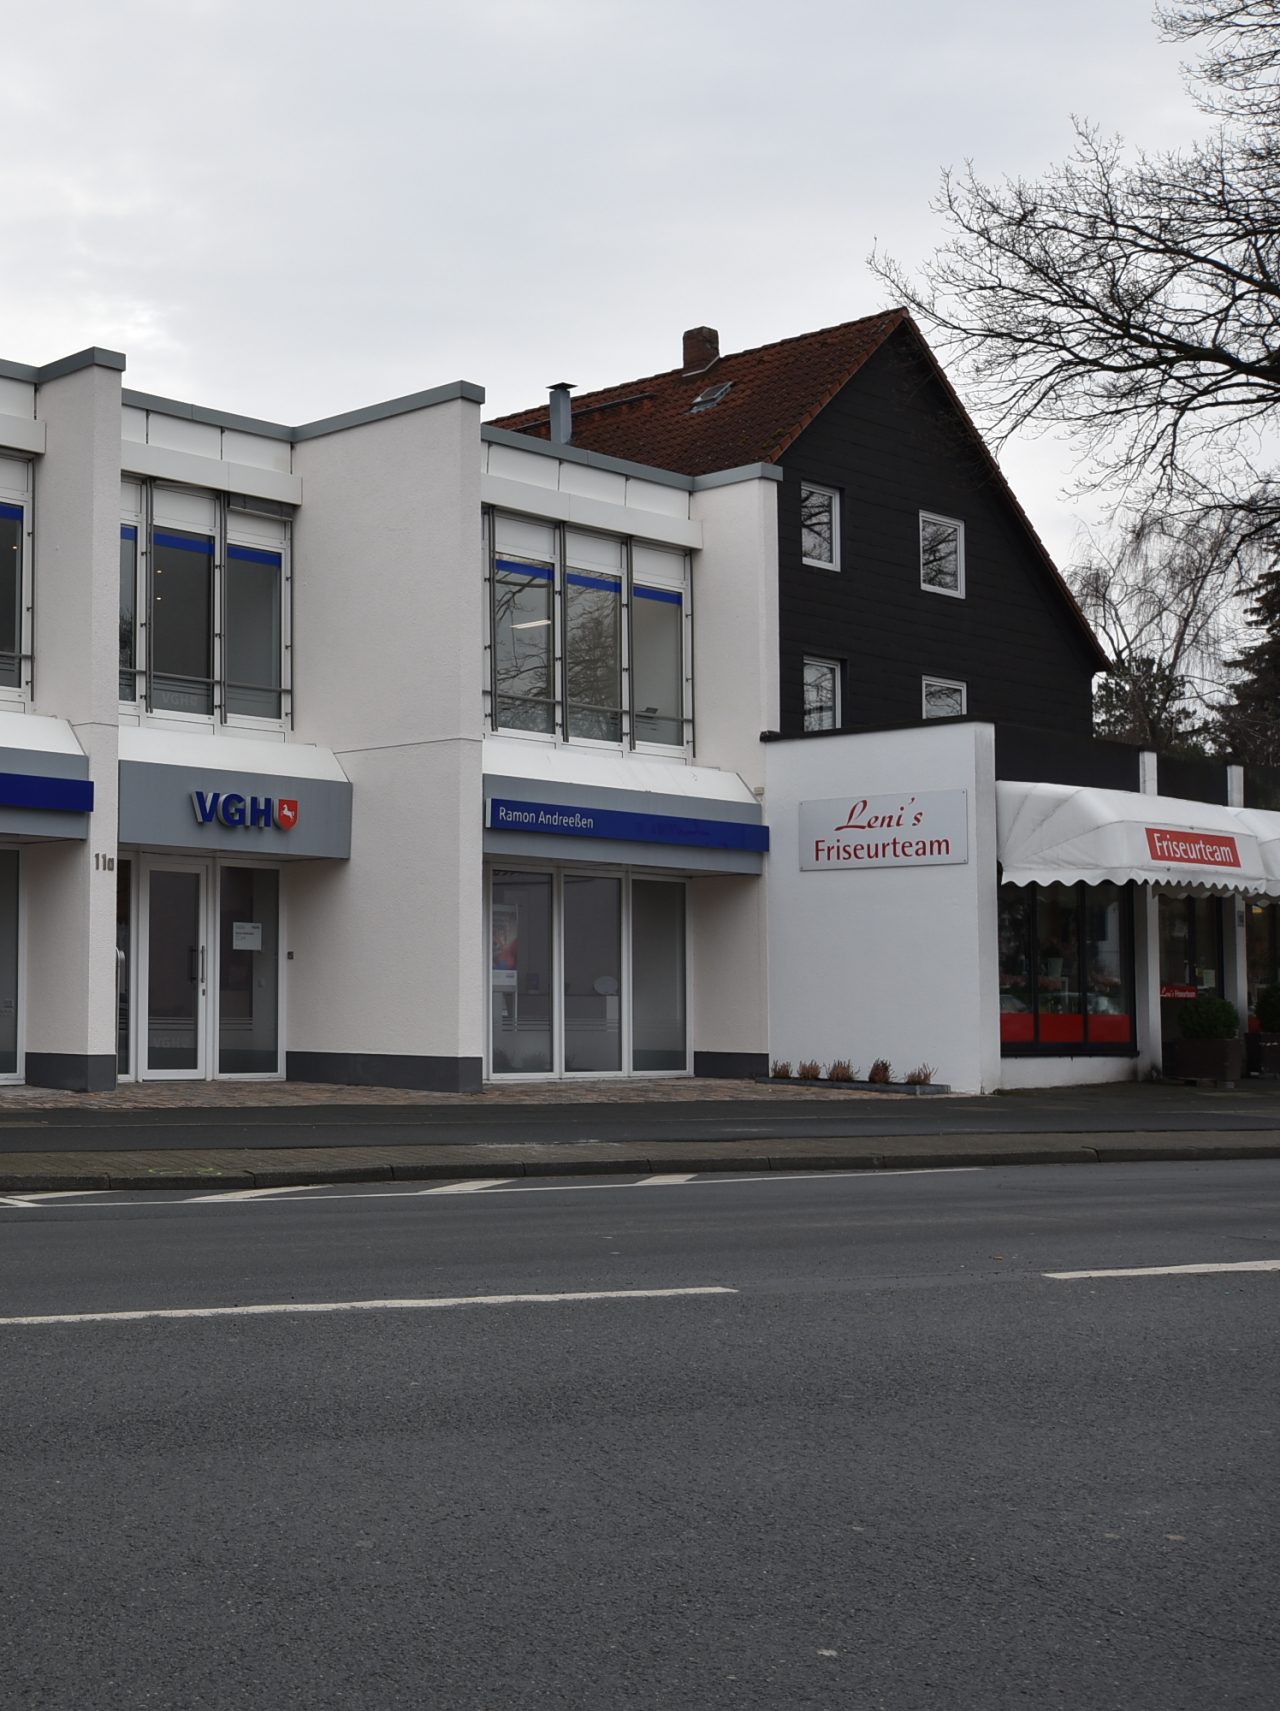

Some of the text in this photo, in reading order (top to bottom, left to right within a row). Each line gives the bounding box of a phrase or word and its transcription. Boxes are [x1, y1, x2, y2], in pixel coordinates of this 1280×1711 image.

[192, 790, 272, 828] VGH
[498, 806, 594, 829] Ramon Andreeßen
[834, 797, 923, 831] Leni's
[815, 837, 950, 861] Friseurteam
[1154, 833, 1235, 863] Friseurteam
[94, 853, 115, 872] 11a
